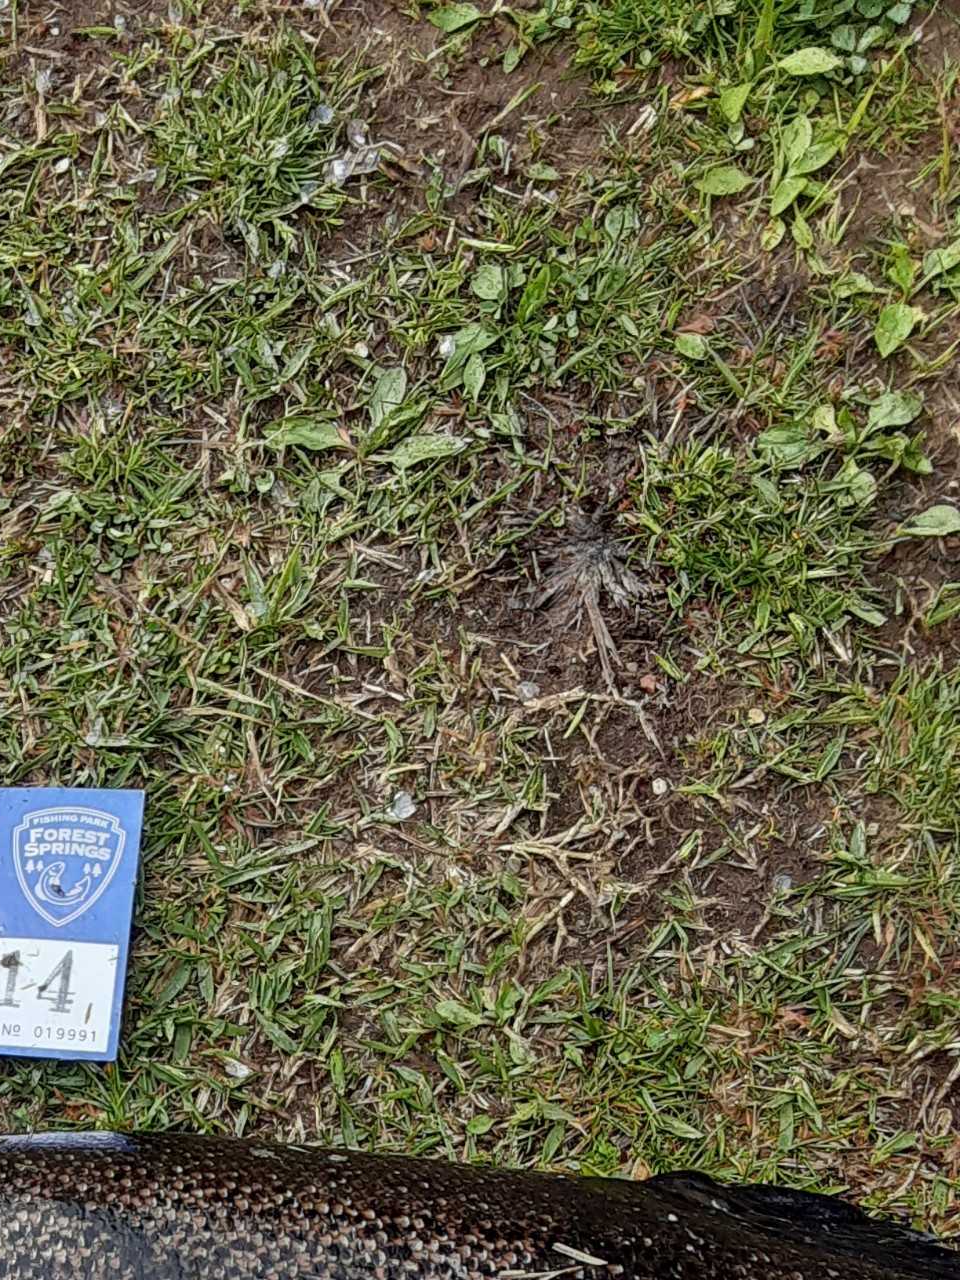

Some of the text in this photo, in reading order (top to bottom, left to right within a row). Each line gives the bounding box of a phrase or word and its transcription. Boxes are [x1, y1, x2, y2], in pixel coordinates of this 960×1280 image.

[32, 814, 110, 829] FISHING PARK
[30, 828, 110, 846] FOREST
[24, 842, 112, 861] SPRINGS
[33, 1025, 97, 1042] 019991
